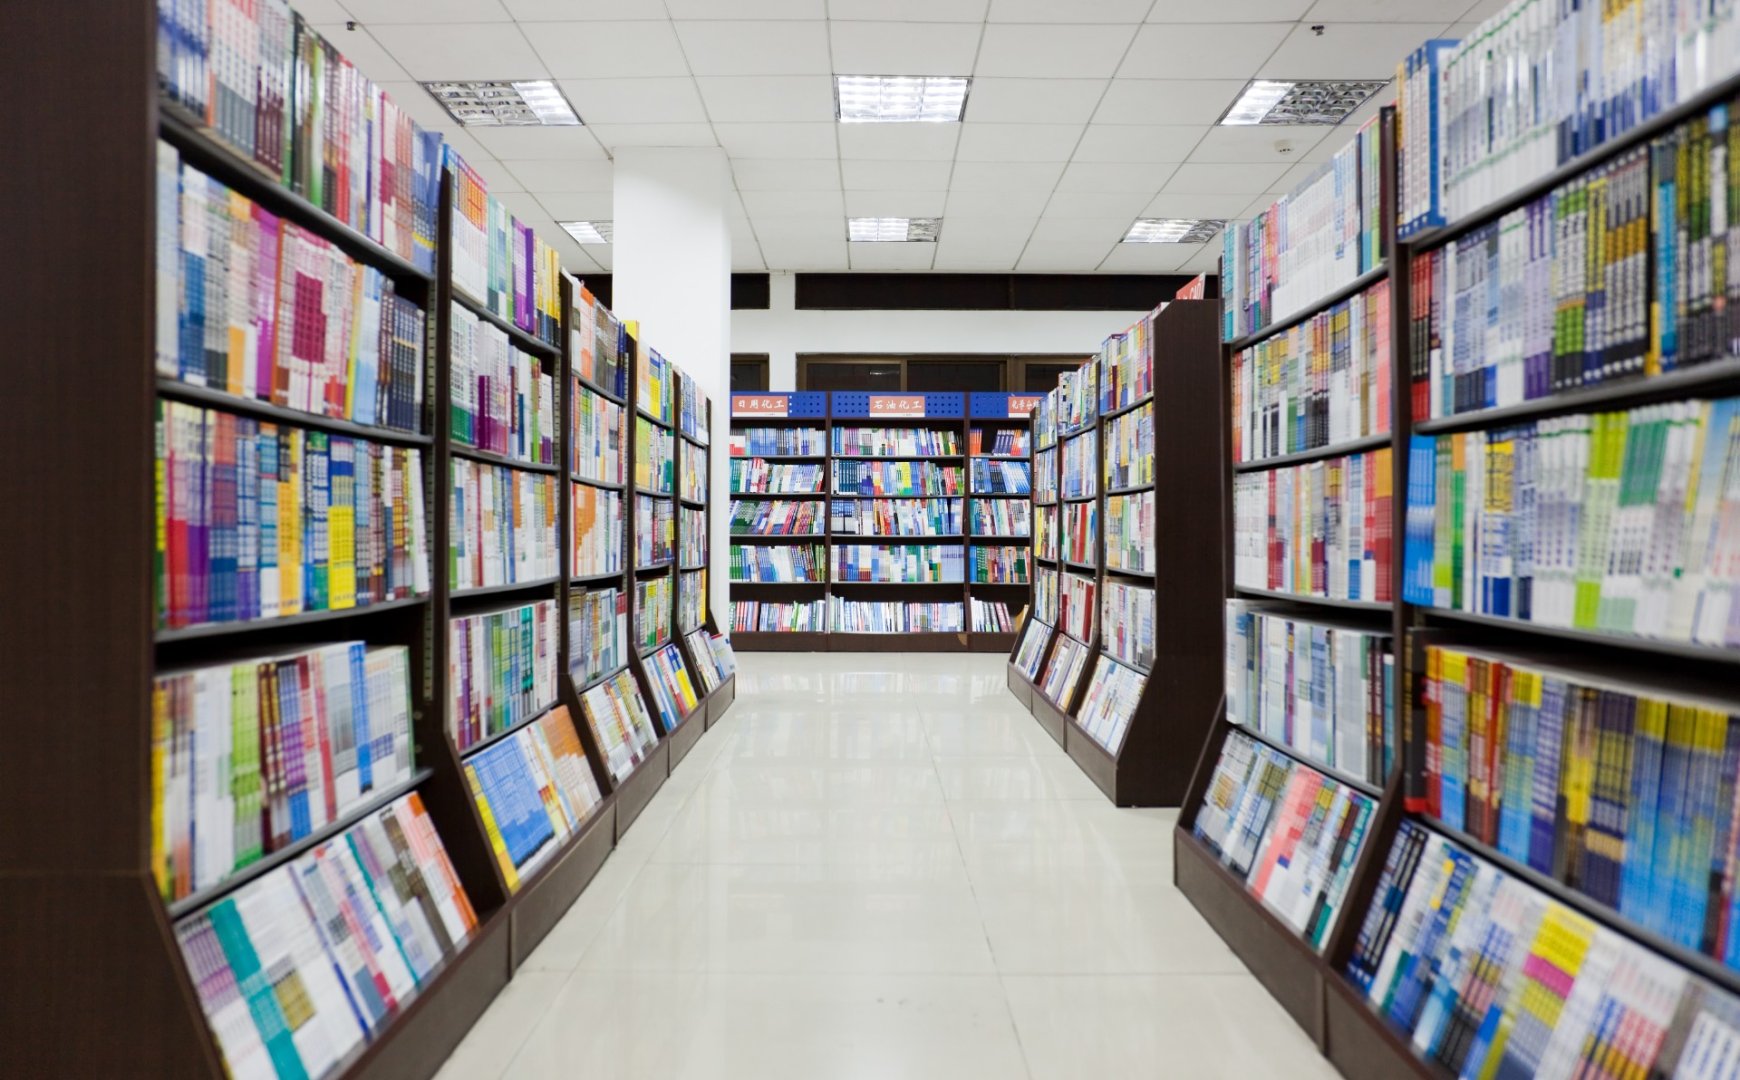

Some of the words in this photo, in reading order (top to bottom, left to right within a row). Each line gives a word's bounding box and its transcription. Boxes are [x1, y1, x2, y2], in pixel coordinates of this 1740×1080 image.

[738, 399, 785, 409] 日用化工
[873, 399, 922, 410] 石油化工
